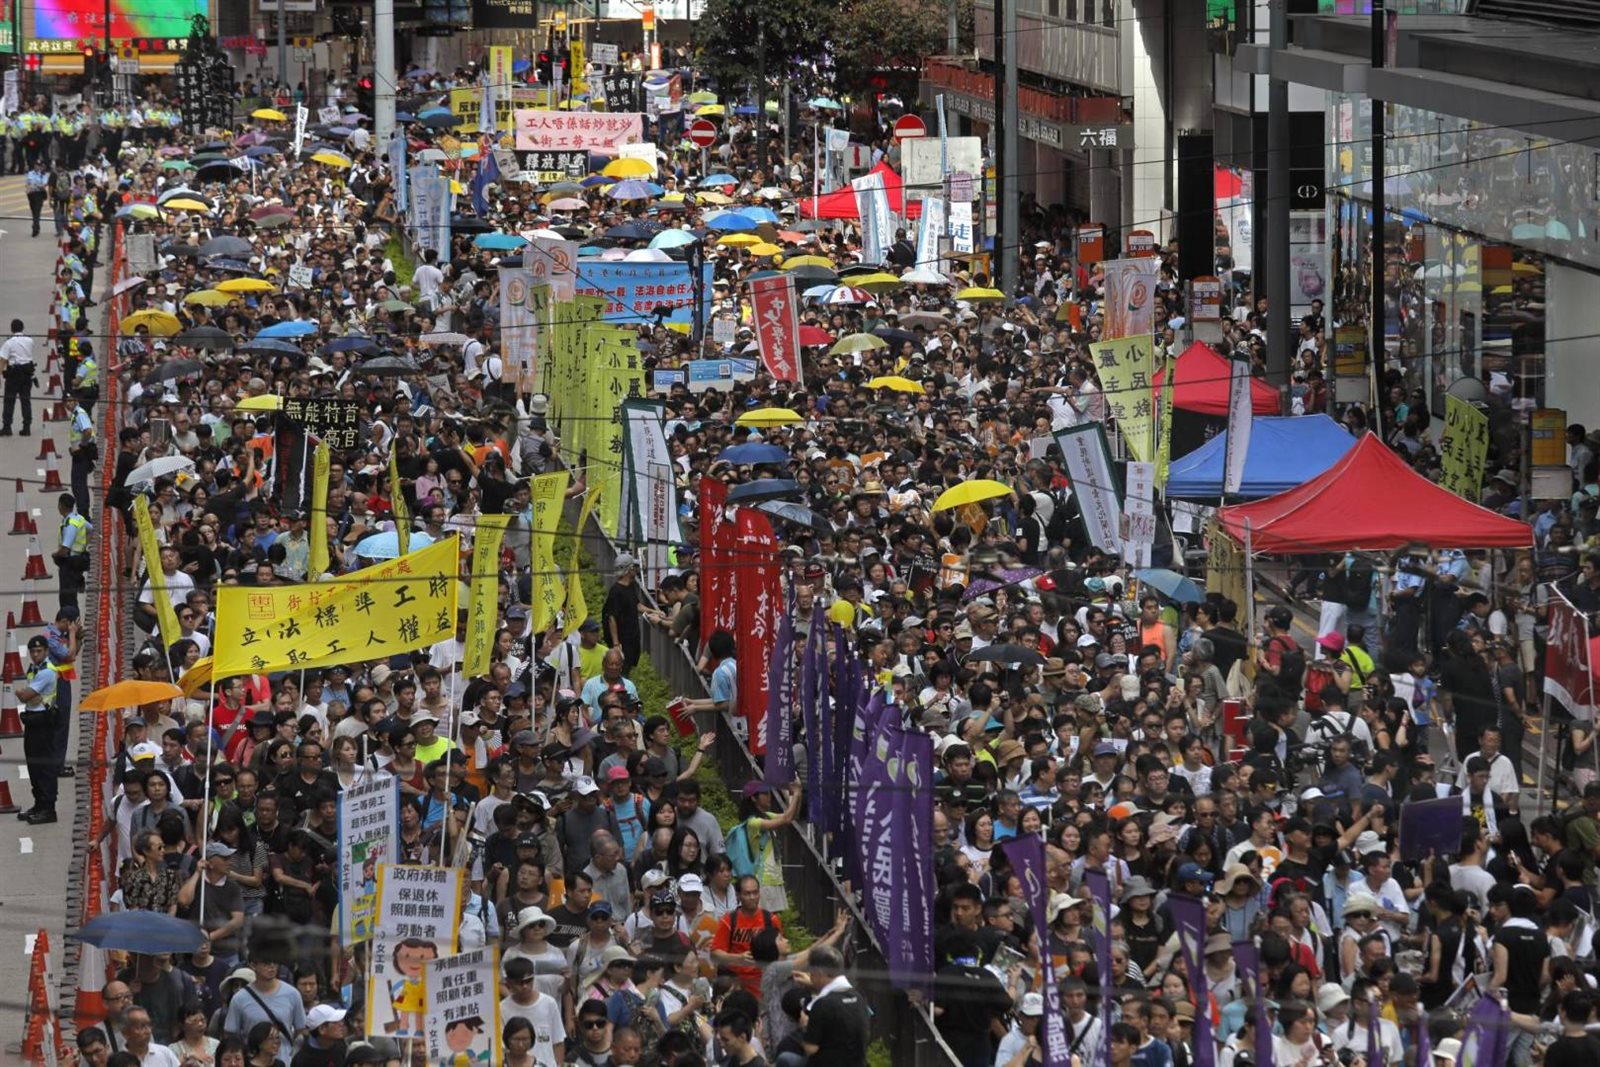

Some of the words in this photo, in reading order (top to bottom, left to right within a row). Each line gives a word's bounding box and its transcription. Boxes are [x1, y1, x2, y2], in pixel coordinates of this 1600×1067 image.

[525, 117, 632, 132] 工人唔係話炒就炒
[1079, 128, 1117, 147] 六福
[286, 400, 359, 423] 無能特首
[240, 571, 449, 648] 立法標準工時
[250, 607, 452, 670] 爭取工人權益
[351, 795, 386, 812] 二等勞工
[347, 825, 390, 846] 工人無保障
[342, 864, 350, 892] 女工會
[393, 868, 447, 882] 政府承擔
[398, 889, 439, 902] 保退休
[390, 903, 444, 918] 照顧無酬
[396, 923, 436, 938] 勞動者
[374, 944, 385, 974] 女工會
[435, 951, 483, 972] 承擔照顧
[442, 971, 477, 988] 責任重
[436, 985, 484, 1005] 照顧者要
[443, 1003, 479, 1021] 有津貼
[430, 1030, 439, 1060] 女工會
